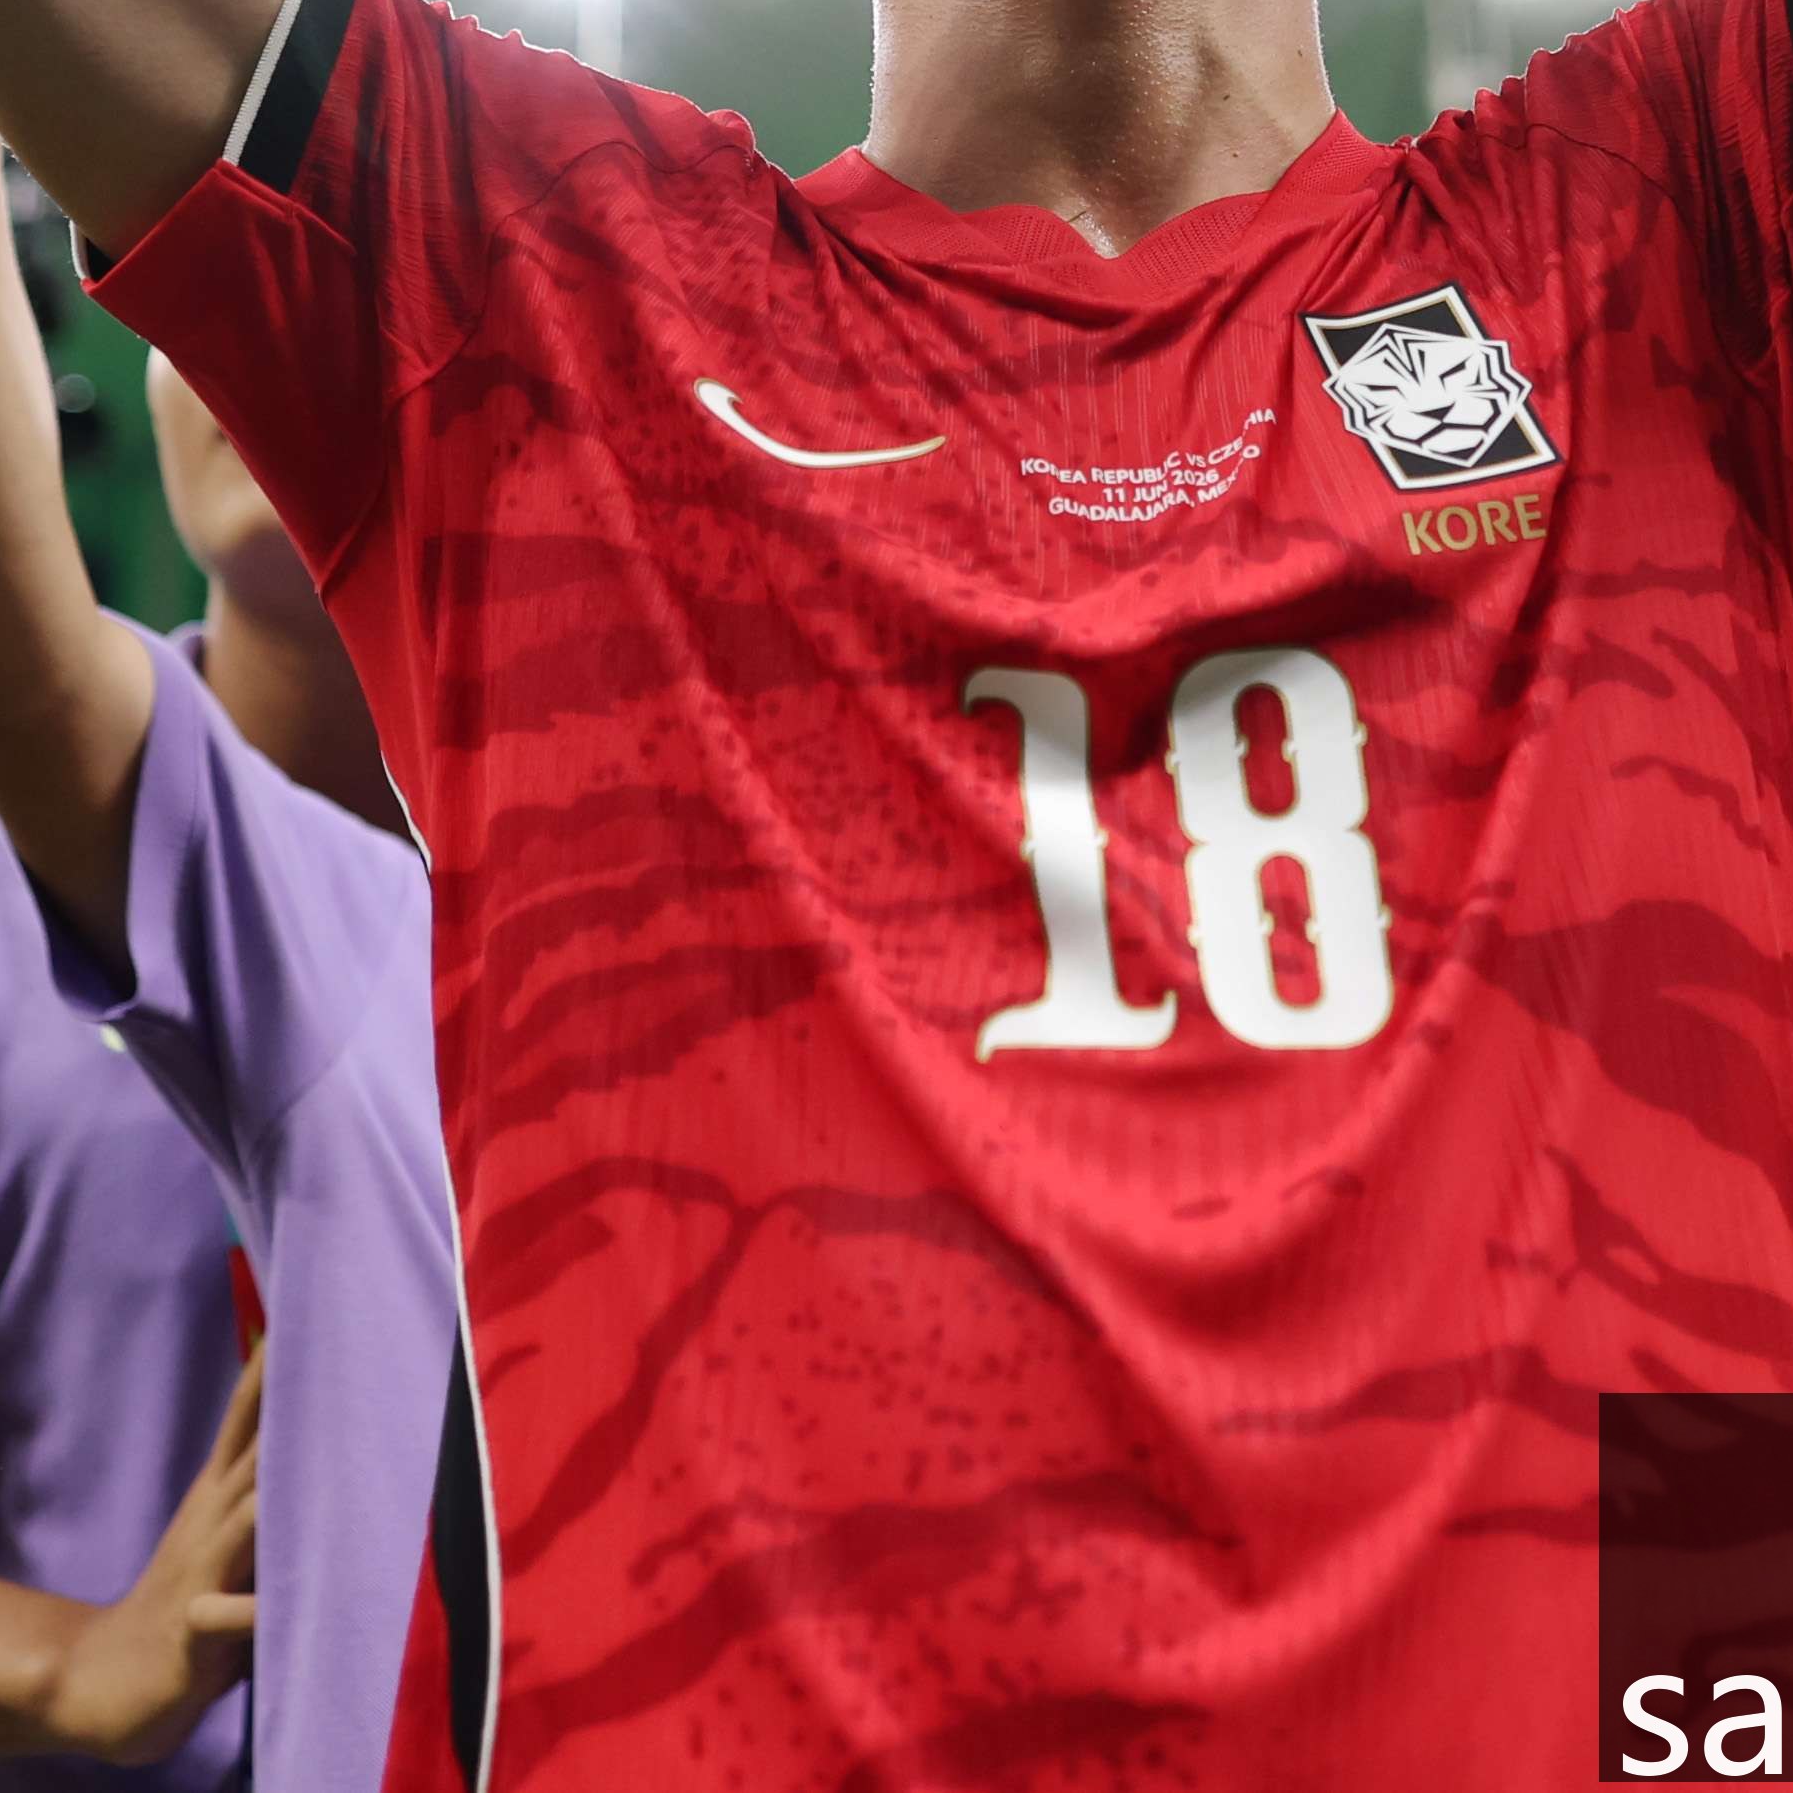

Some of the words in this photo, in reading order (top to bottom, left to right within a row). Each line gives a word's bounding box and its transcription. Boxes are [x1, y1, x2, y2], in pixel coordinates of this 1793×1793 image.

[1020, 458, 1086, 484] KOREA
[1090, 451, 1182, 485] REPUBLIC
[1185, 452, 1207, 468] VS
[1048, 489, 1196, 522] GUADALAJARA,
[1197, 444, 1261, 503] MEXO
[1102, 487, 1126, 503] 11
[1132, 480, 1169, 503] JUN
[1171, 468, 1220, 487] 2026
[1402, 493, 1547, 556] KORE
[964, 645, 1394, 1063] 18
